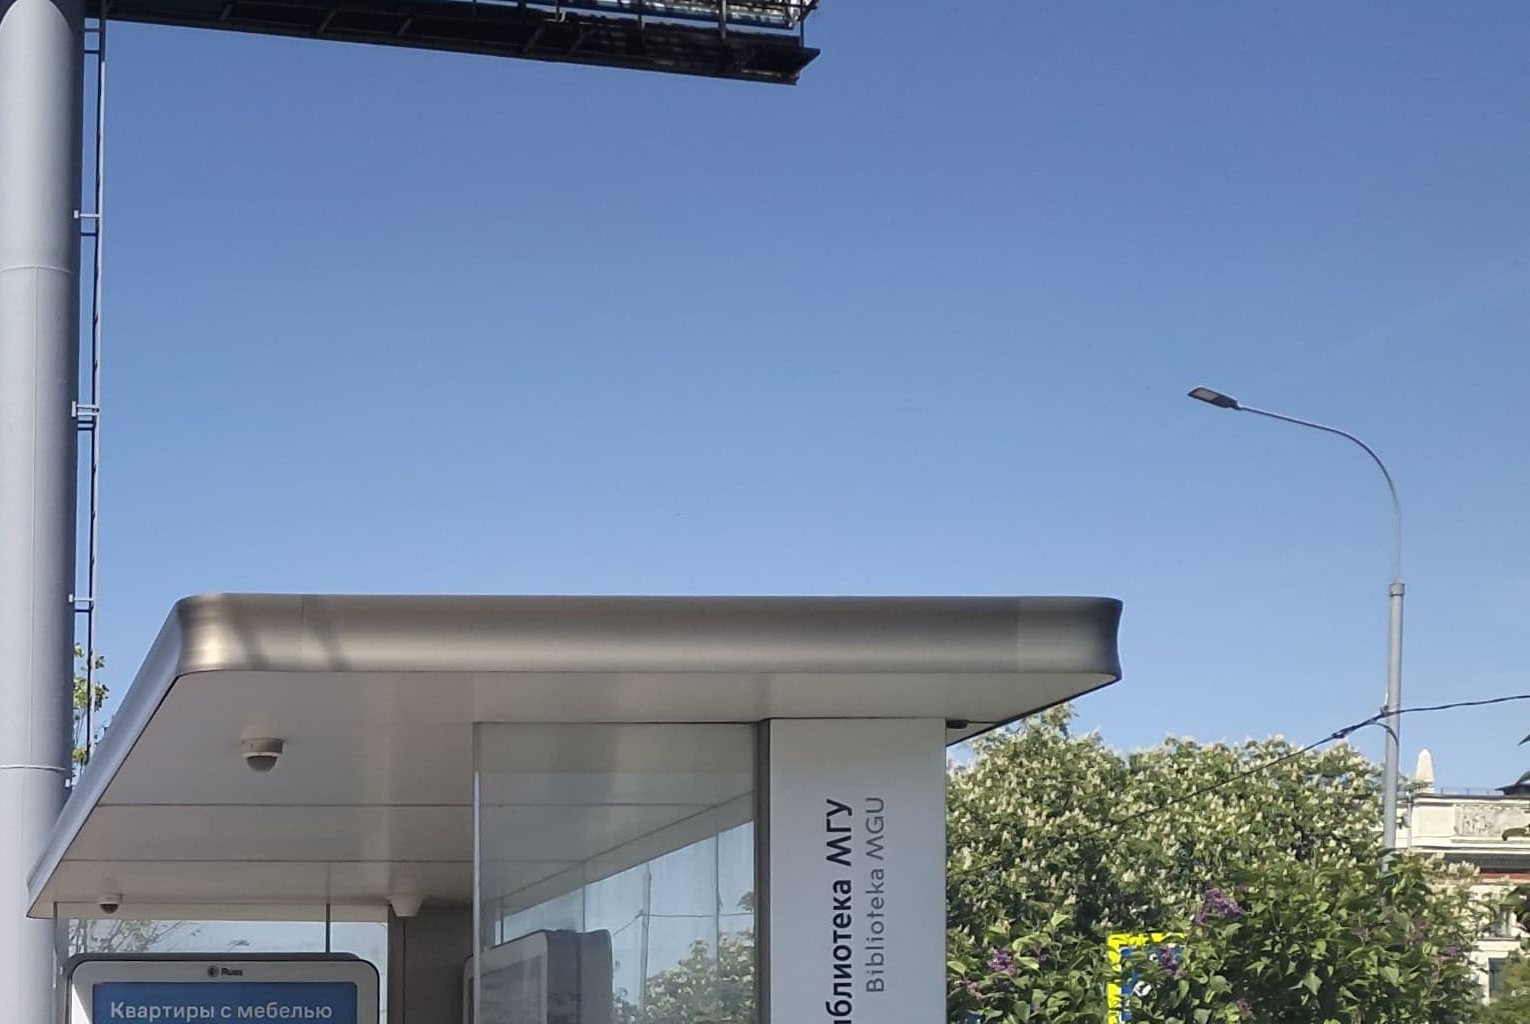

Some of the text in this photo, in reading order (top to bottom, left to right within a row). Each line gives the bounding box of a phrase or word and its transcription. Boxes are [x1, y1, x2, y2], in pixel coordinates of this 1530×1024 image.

[826, 799, 852, 866] МГУ
[865, 798, 884, 992] Biblioteka MGU
[111, 1001, 332, 1022] Квартиры с мебелью
